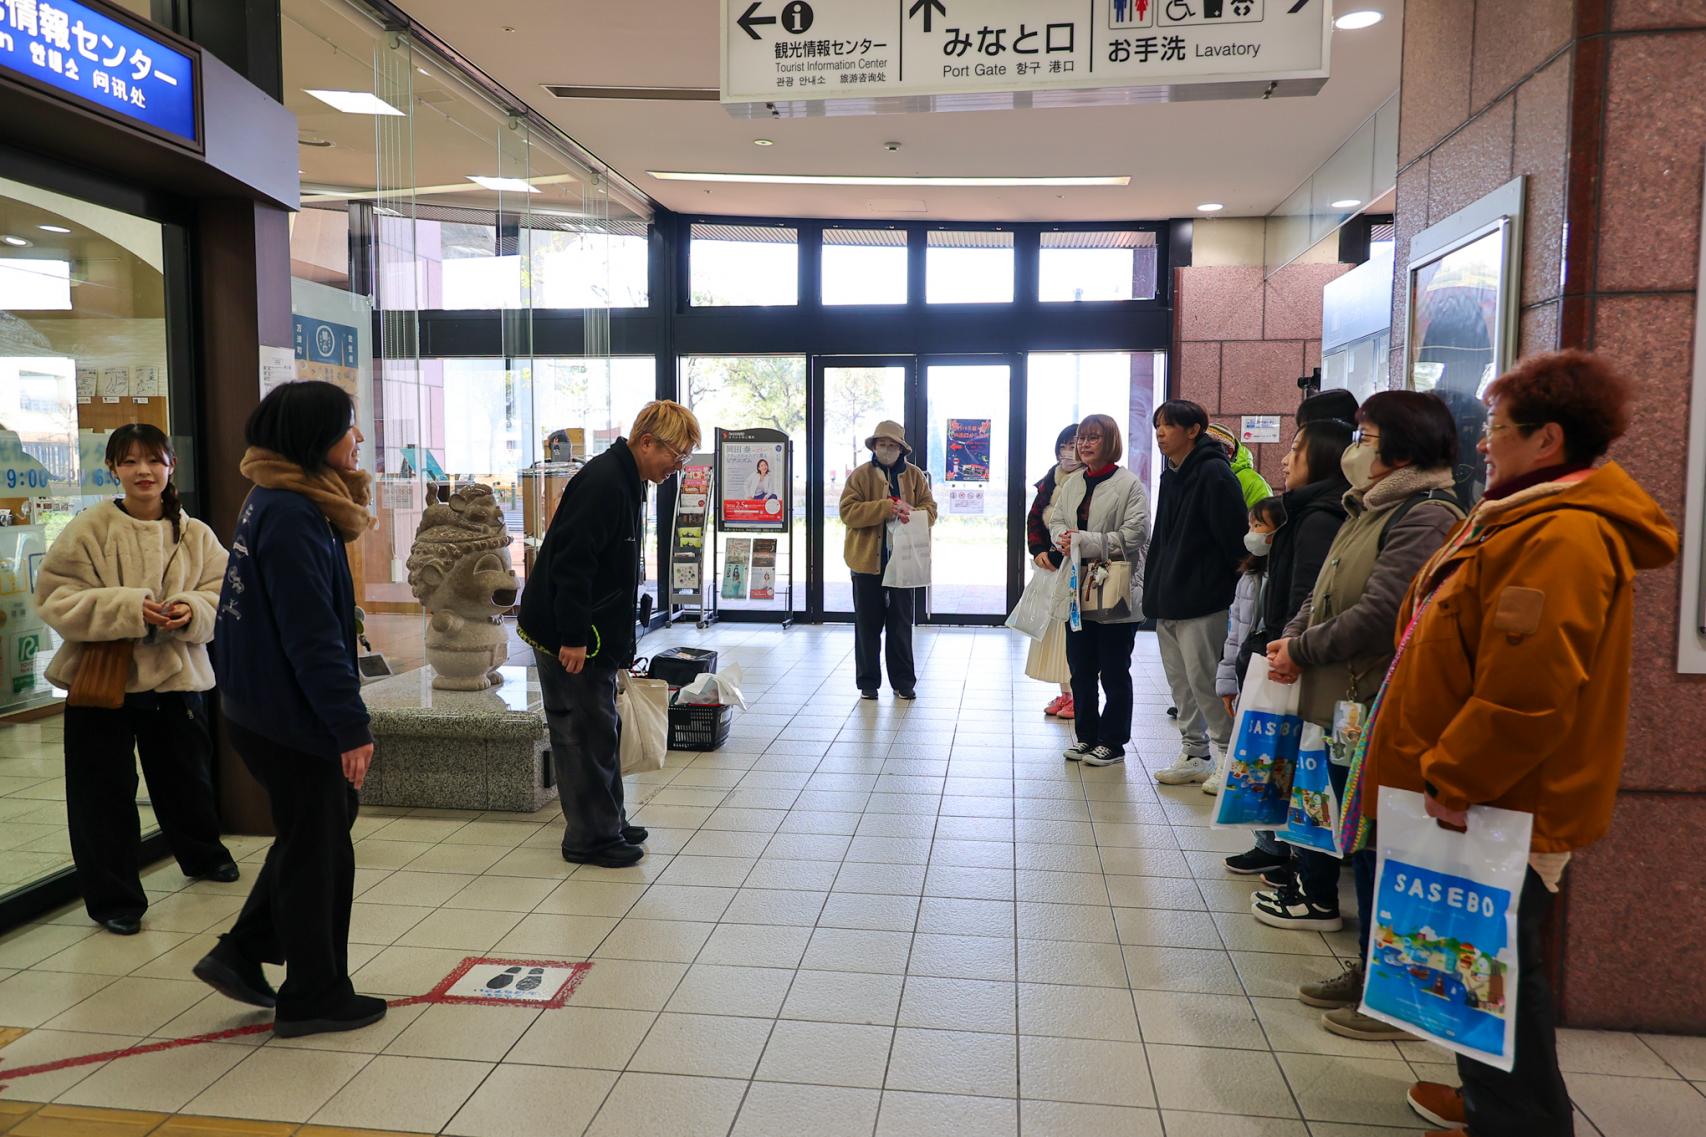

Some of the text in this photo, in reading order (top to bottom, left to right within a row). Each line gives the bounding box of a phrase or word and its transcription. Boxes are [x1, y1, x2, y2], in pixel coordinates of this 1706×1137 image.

[0, 0, 177, 86] 情報センター
[774, 39, 887, 59] 観光情報センター
[943, 22, 1075, 57] みなと口
[1108, 36, 1261, 63] お手洗 Lavatory
[775, 58, 888, 73] Tourist Information Center
[943, 59, 1075, 78] Port Gate 항구 港口
[92, 69, 147, 109] 问讯处
[776, 76, 794, 87] 관광
[799, 75, 826, 86] 안내소
[1394, 873, 1494, 917] SASEBO
